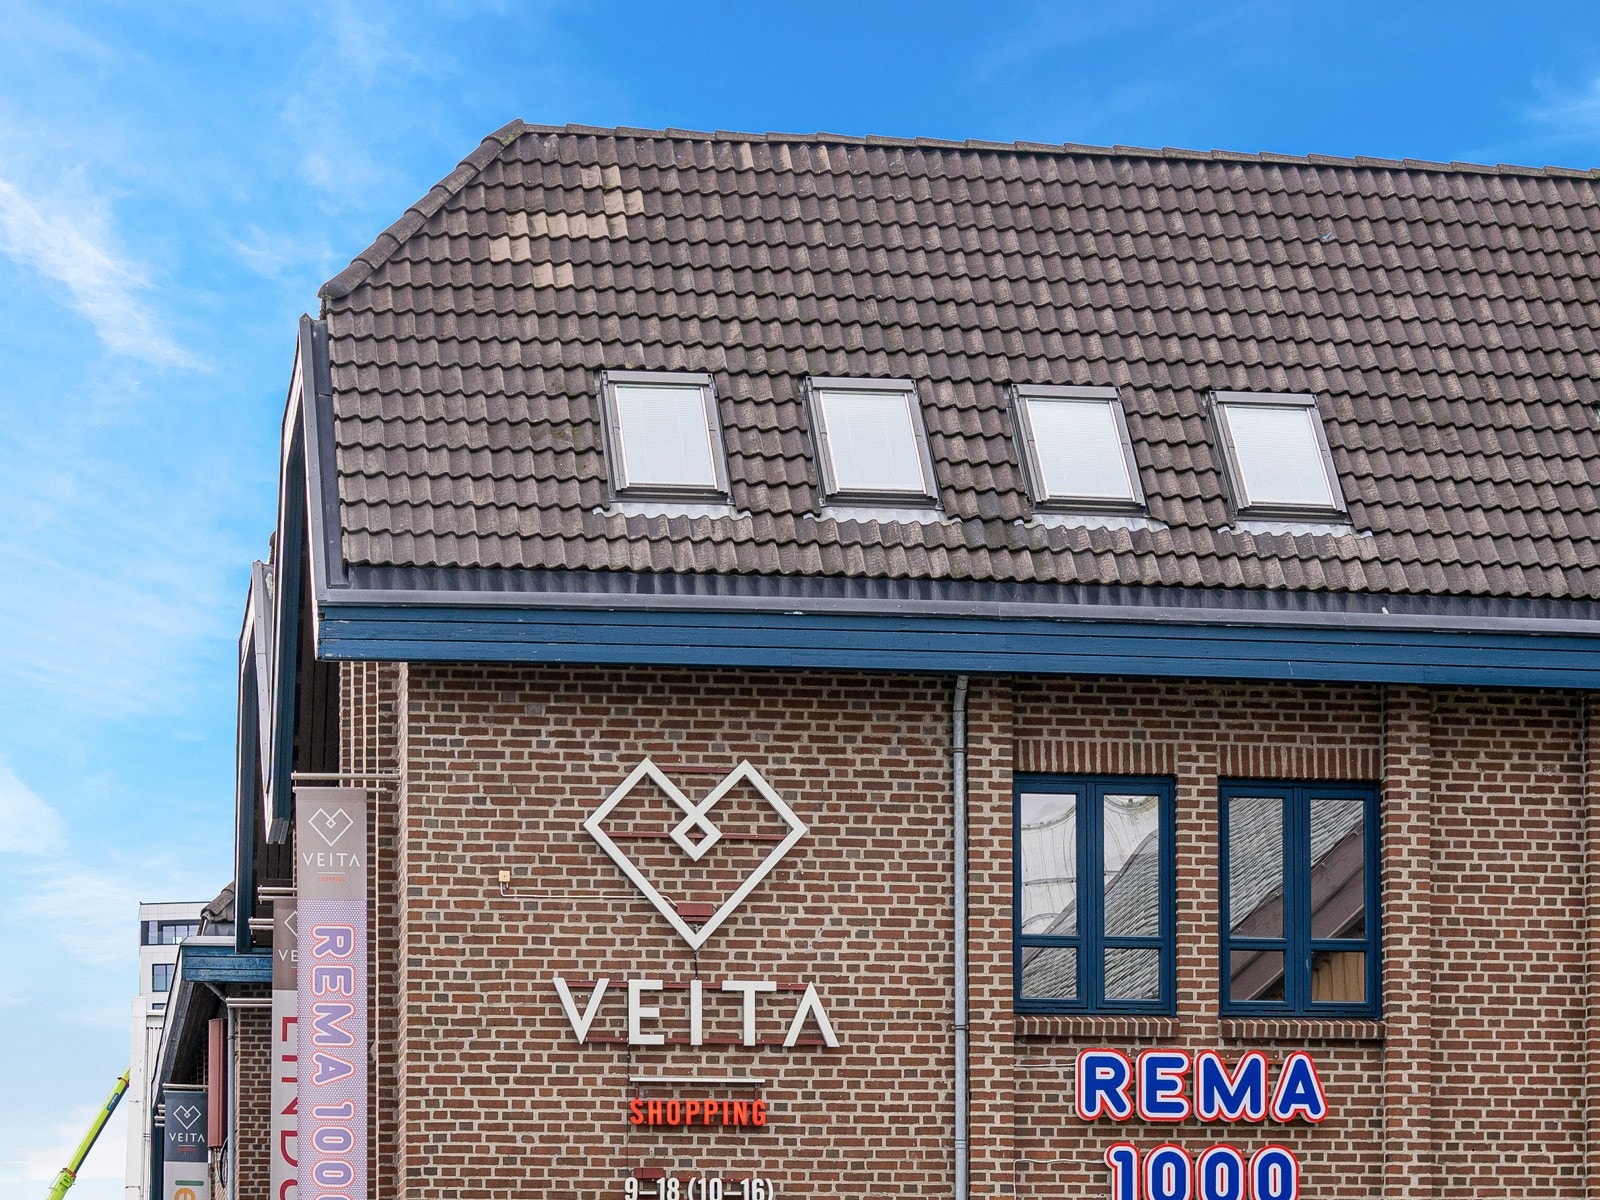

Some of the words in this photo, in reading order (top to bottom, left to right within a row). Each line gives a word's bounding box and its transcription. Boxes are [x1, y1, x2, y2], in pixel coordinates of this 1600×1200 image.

[302, 852, 361, 867] VEITA
[310, 922, 356, 1088] REMA
[552, 977, 841, 1048] VEITA
[1075, 1047, 1329, 1123] REMA
[629, 1098, 767, 1126] SHOPPING
[168, 1132, 205, 1143] VEITA
